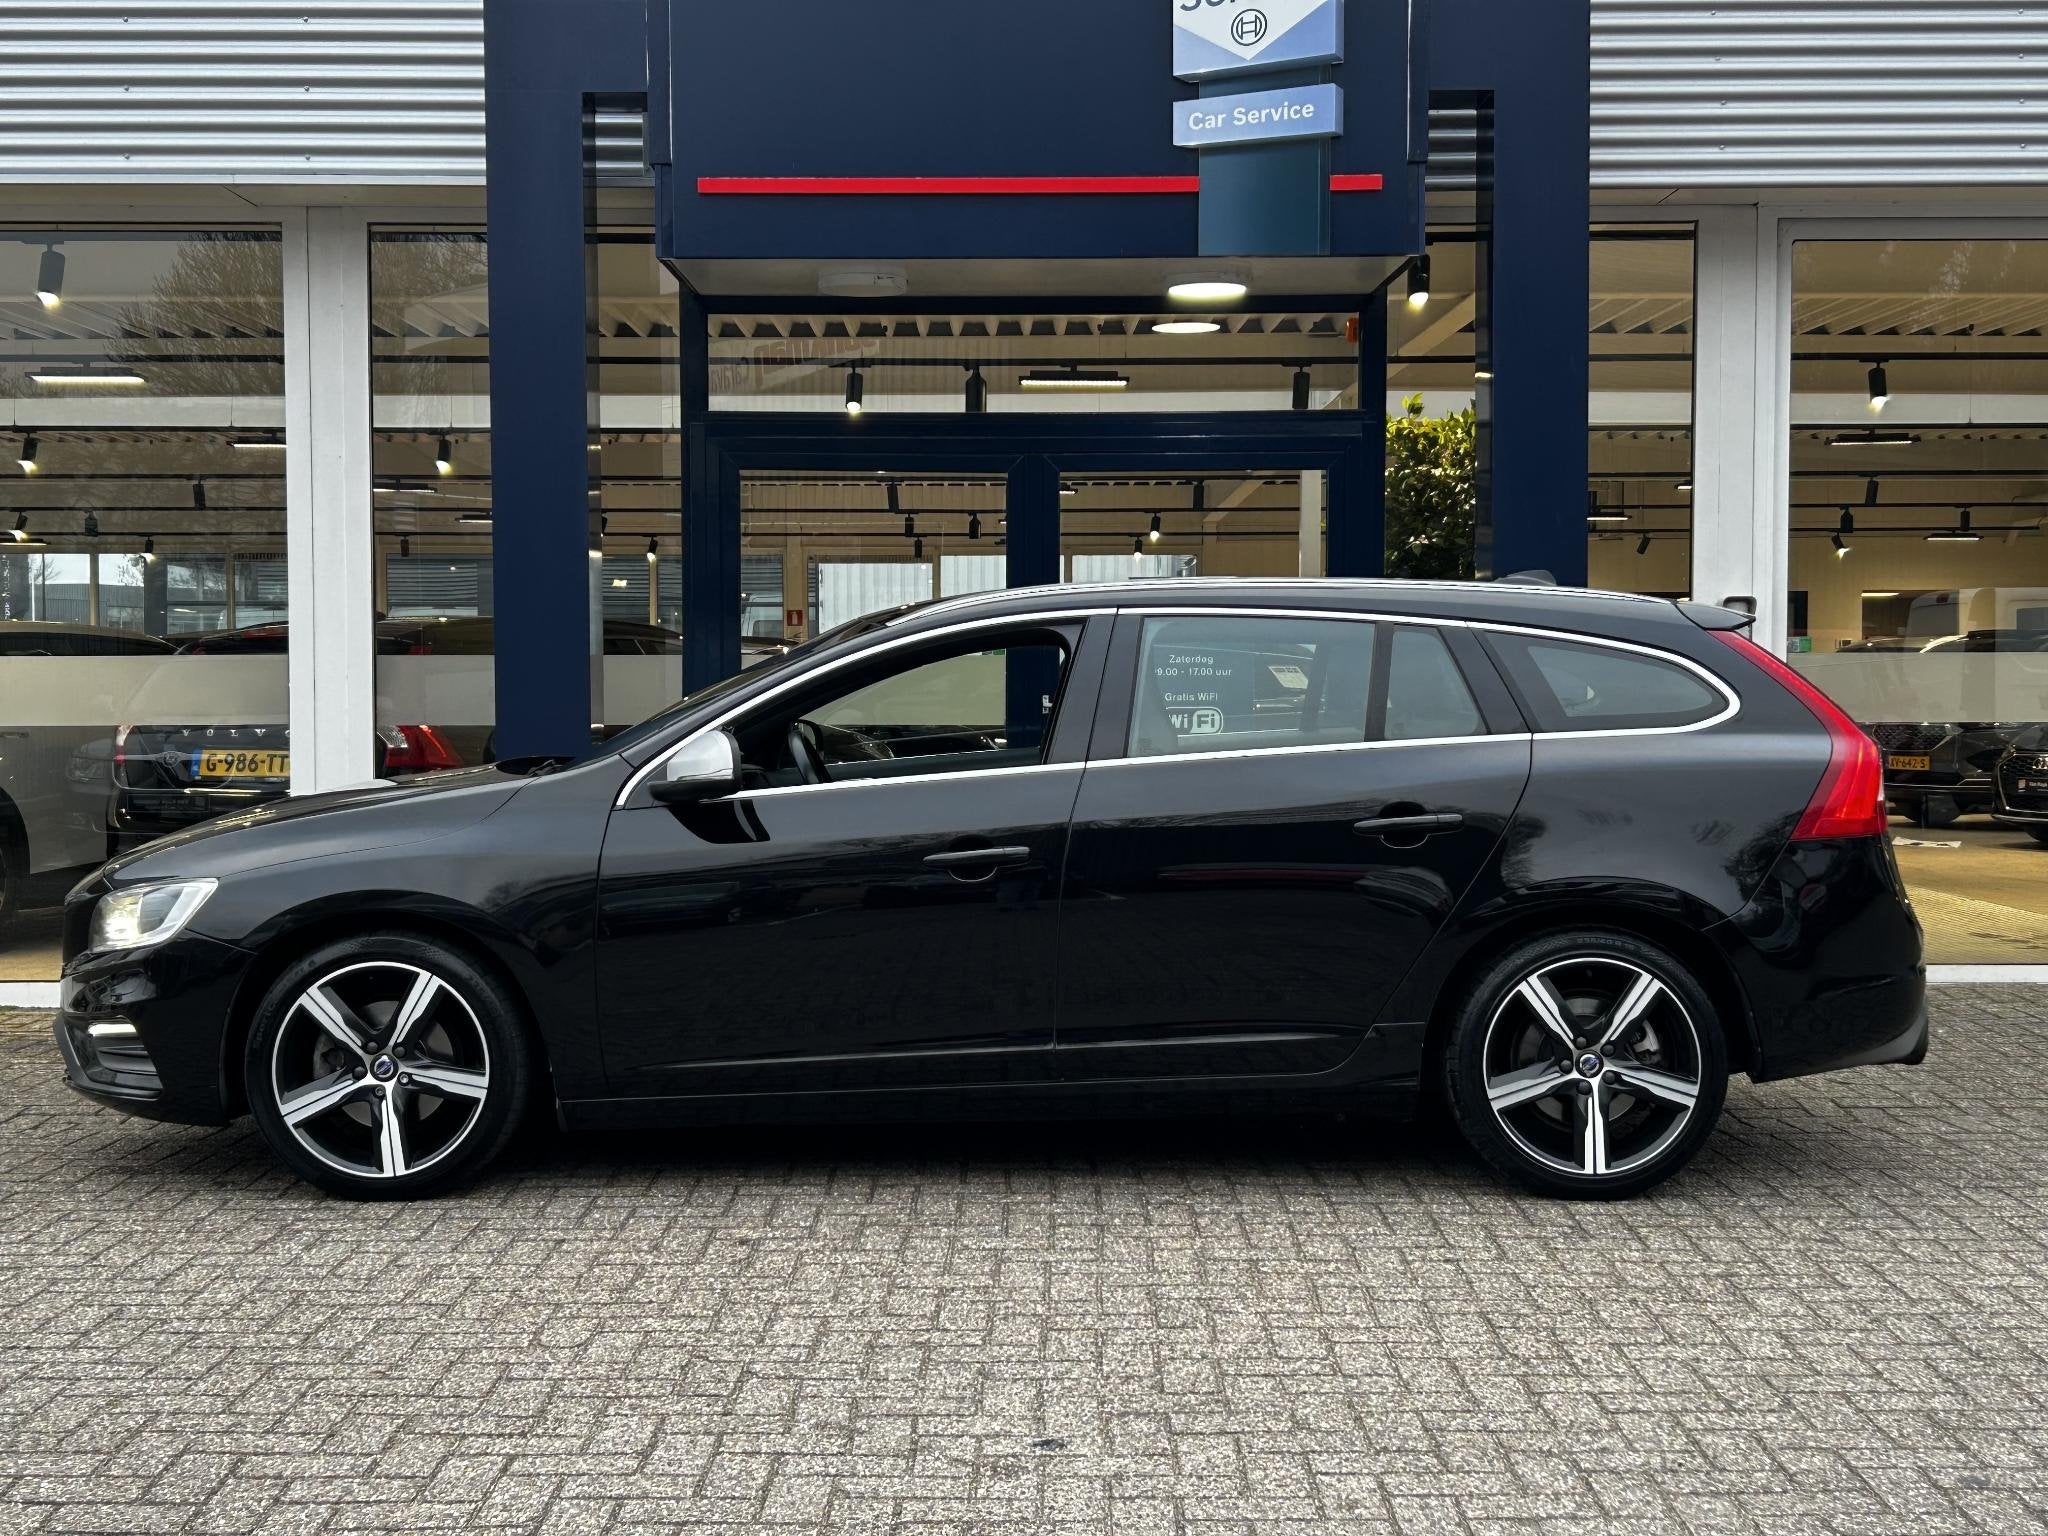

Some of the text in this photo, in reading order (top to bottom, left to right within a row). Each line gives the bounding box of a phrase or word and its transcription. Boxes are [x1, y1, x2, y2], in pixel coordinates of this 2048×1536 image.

[1188, 101, 1315, 131] Car Service
[1169, 654, 1214, 664] Zaterdag
[1189, 667, 1213, 676] 17.00
[1164, 692, 1195, 701] Gratis
[205, 752, 290, 773] G-986-TT
